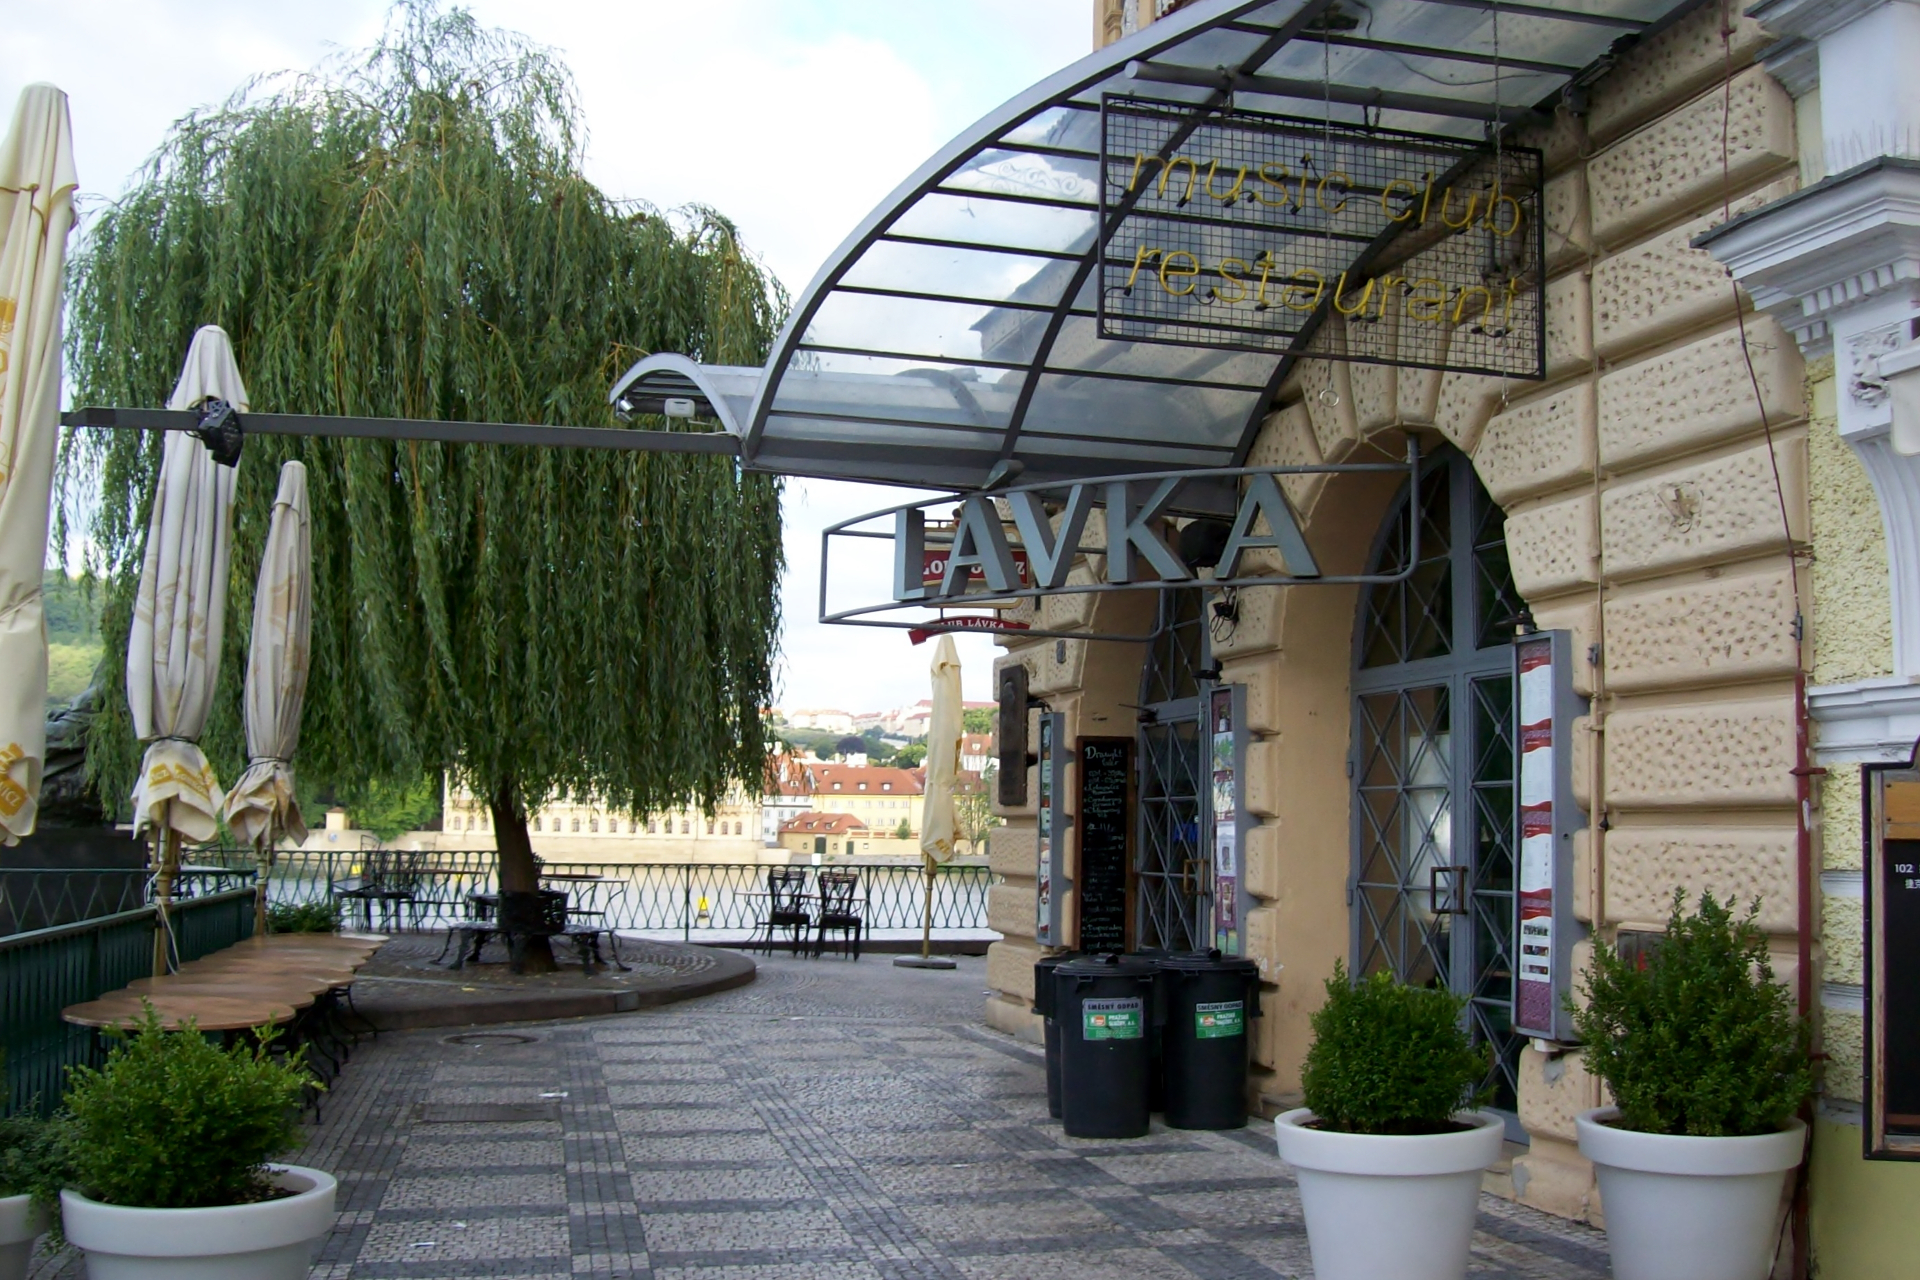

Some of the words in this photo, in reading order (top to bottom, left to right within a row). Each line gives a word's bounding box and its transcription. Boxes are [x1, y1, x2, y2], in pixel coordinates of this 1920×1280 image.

[1128, 152, 1353, 214] music
[1382, 170, 1521, 237] club
[1128, 244, 1519, 333] restaurant
[1895, 863, 1914, 873] 102
